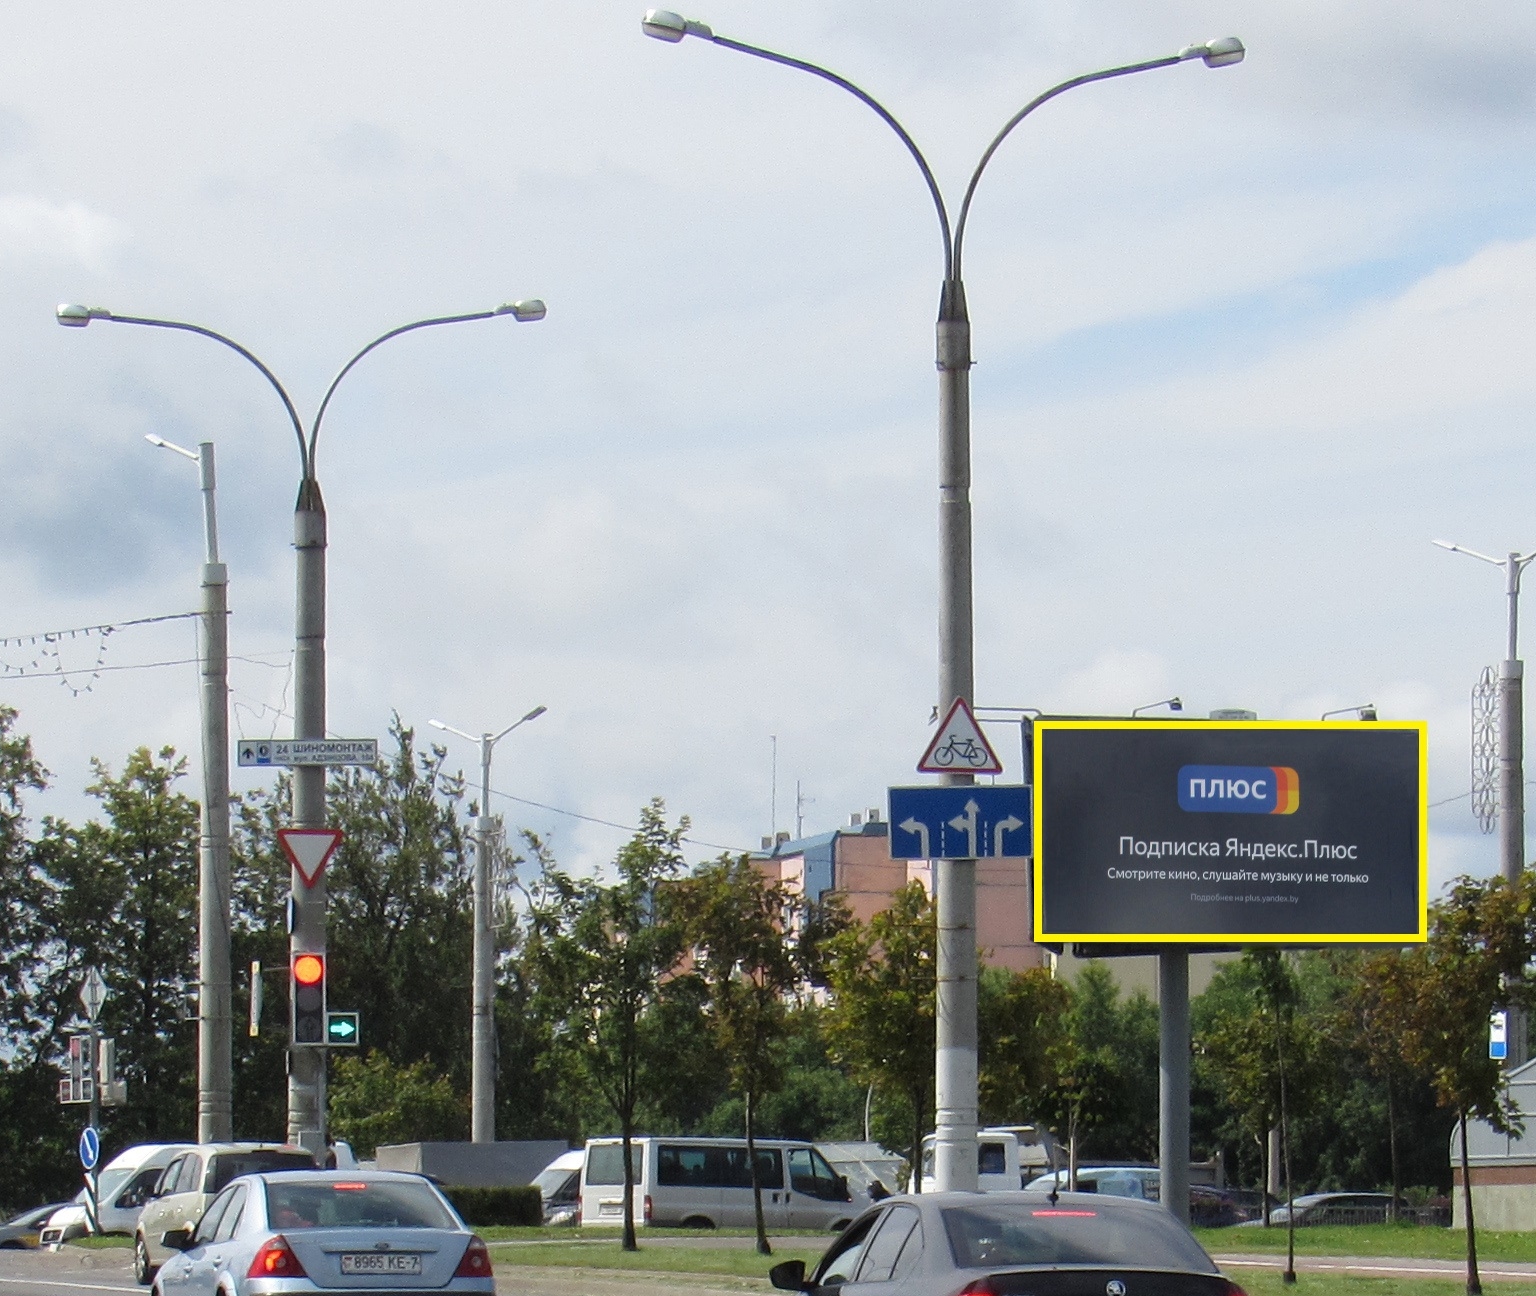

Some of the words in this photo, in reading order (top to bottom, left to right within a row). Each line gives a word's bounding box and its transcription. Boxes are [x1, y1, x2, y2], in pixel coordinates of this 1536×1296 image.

[276, 744, 289, 754] 24
[292, 743, 373, 753] ШИНОМОНТАЖ
[1189, 777, 1268, 800] ПЛЮС
[1119, 836, 1221, 859] Подписка
[1225, 837, 1358, 860] Яндекс.Плюс
[1107, 867, 1166, 881] Смотрите
[1168, 871, 1200, 881] кино,
[1203, 869, 1259, 882] слушайте
[1261, 872, 1303, 883] музыку
[1305, 873, 1313, 882] и
[1315, 873, 1329, 882] не
[1331, 873, 1369, 884] только
[1190, 893, 1234, 903] Подробнее
[1245, 894, 1299, 904] plus.yandex.by
